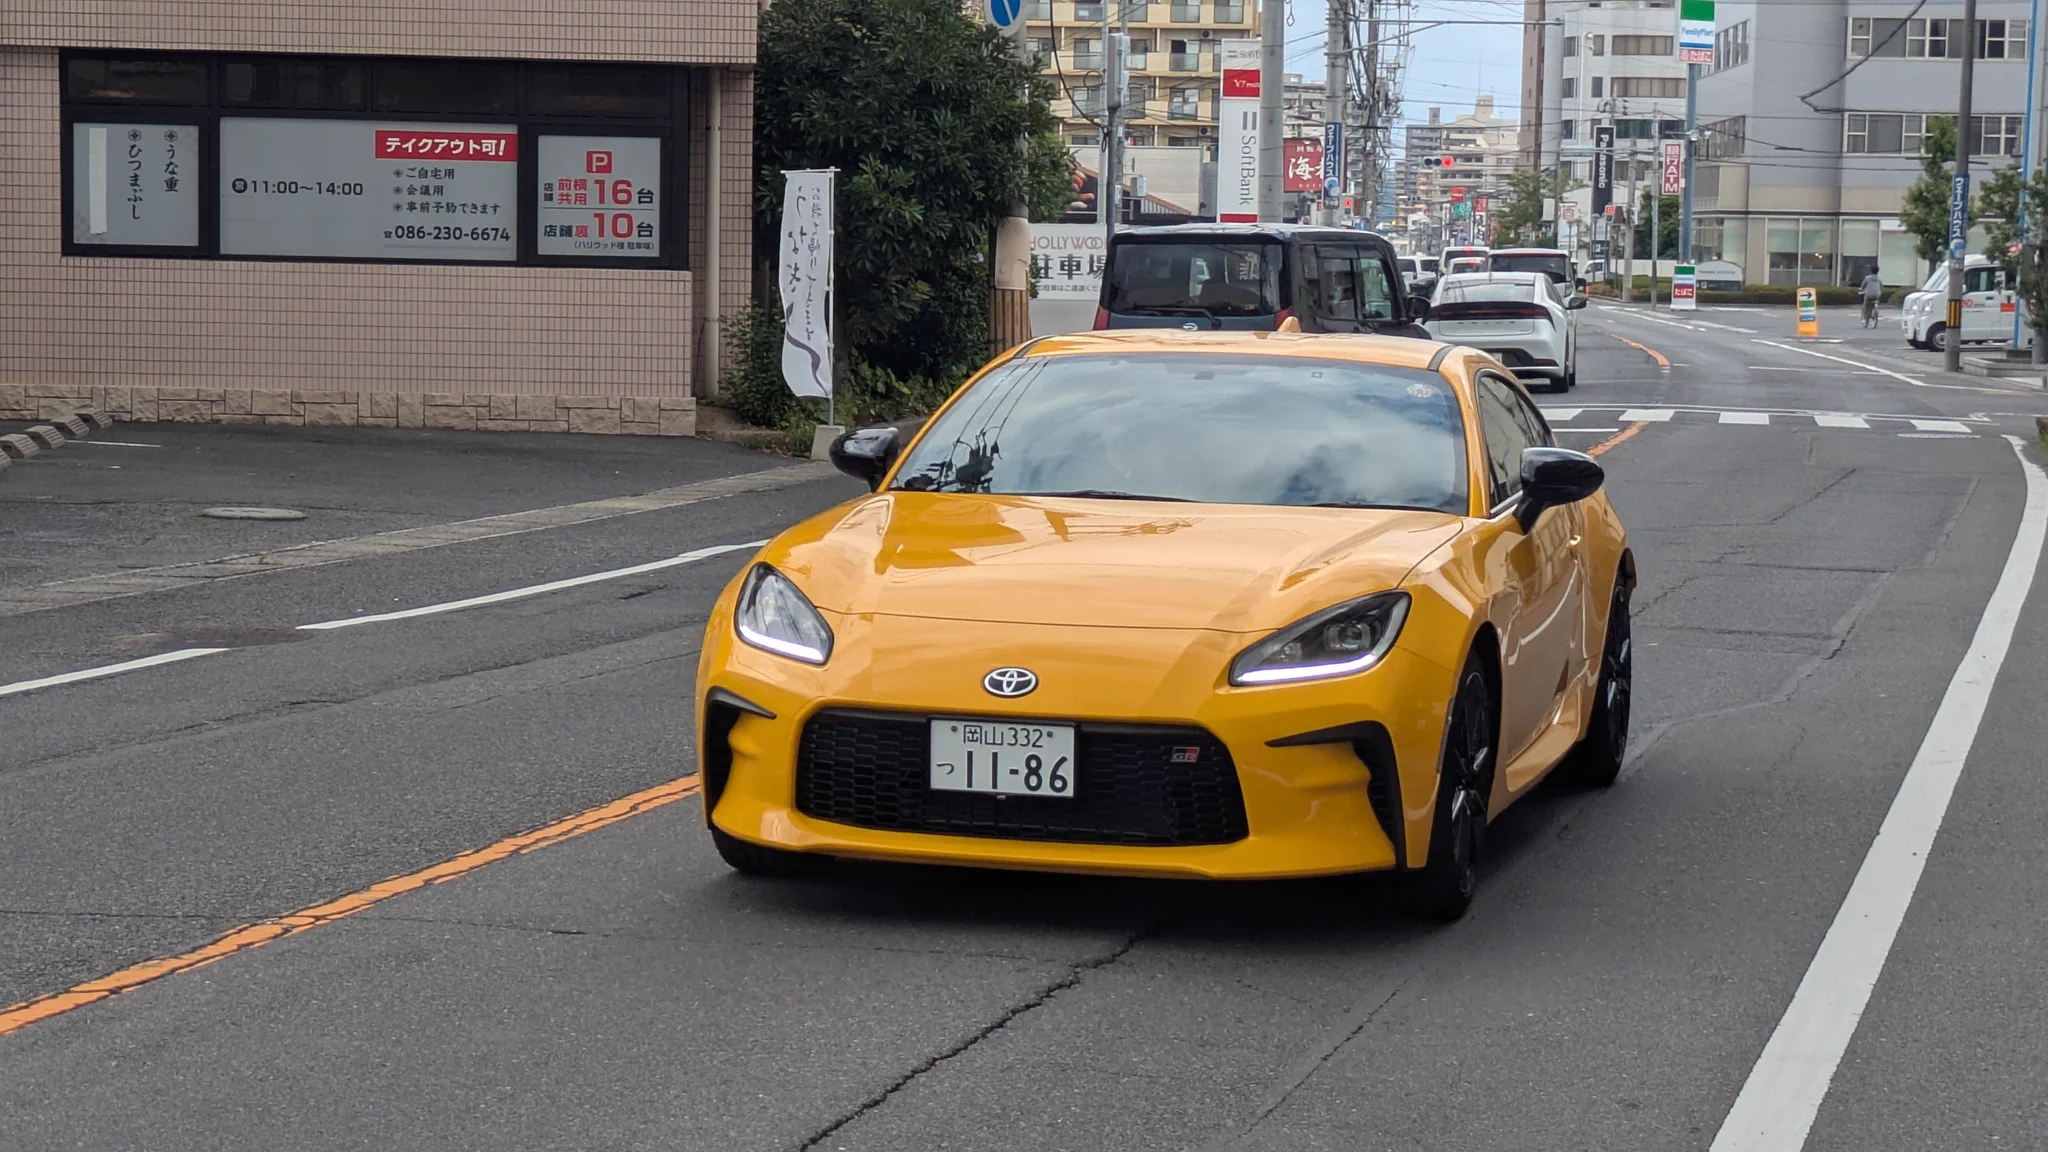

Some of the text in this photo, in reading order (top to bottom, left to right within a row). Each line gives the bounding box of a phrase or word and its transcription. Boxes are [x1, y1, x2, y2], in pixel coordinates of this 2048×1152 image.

[386, 138, 505, 156] テイクアウト可!
[164, 144, 180, 192] うな重
[592, 153, 608, 172] P
[1240, 136, 1256, 206] SoftBank
[1599, 134, 1609, 189] Panasonic
[128, 144, 143, 220] ひつまぶし
[406, 168, 455, 180] ご自宅用
[407, 184, 444, 196] 会議用
[593, 179, 633, 205] 16
[636, 188, 655, 204] 台
[406, 201, 500, 215] 事前予約できます
[394, 225, 511, 241] 086-230-6674
[592, 213, 634, 238] 10
[636, 222, 655, 238] 台
[1030, 236, 1105, 250] HOLLYWOO
[936, 750, 1068, 793] つ 11-86
